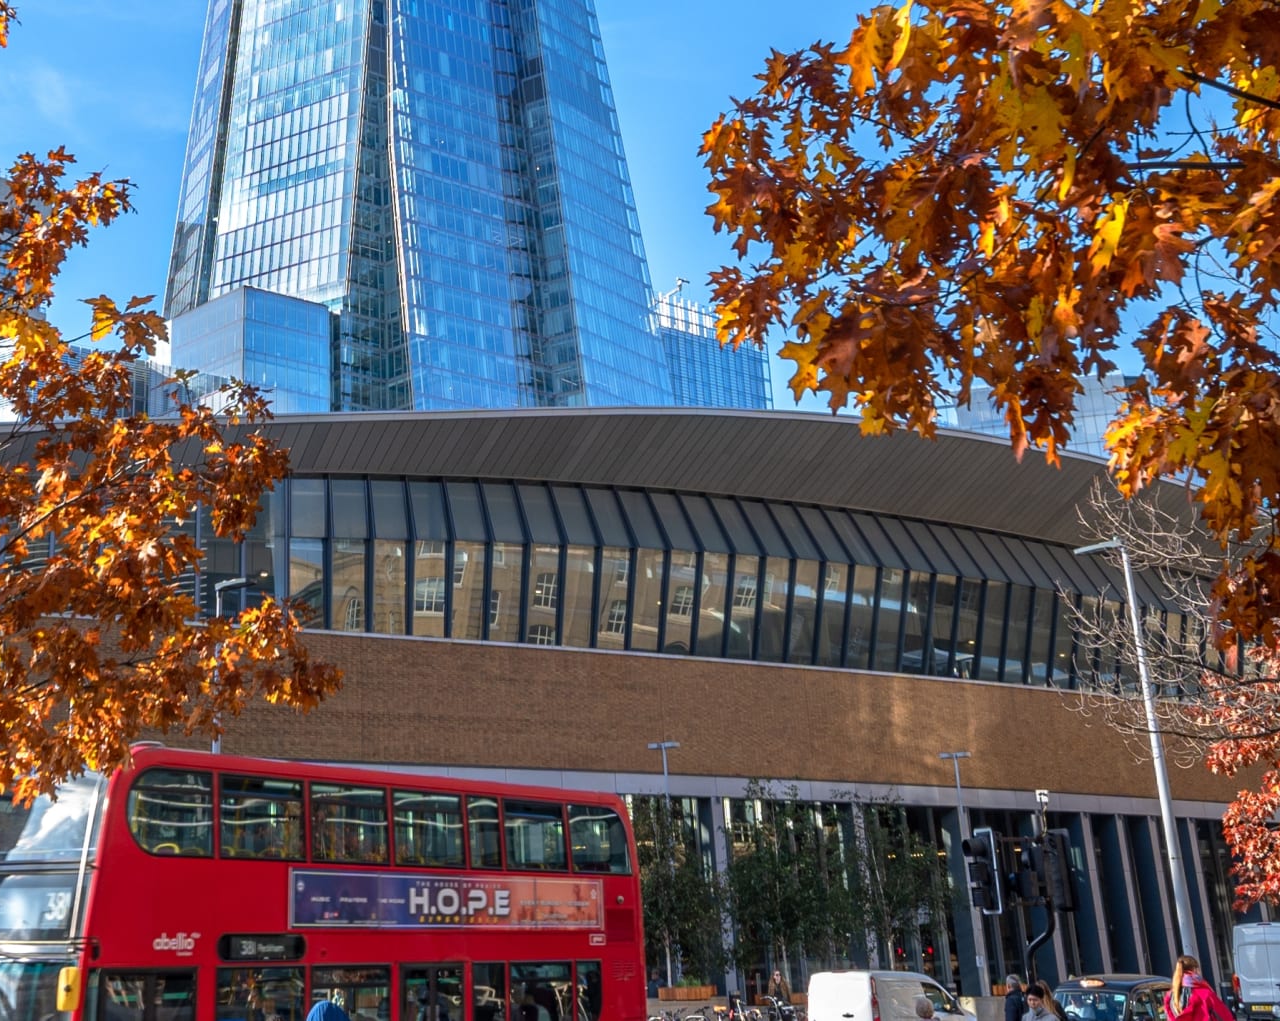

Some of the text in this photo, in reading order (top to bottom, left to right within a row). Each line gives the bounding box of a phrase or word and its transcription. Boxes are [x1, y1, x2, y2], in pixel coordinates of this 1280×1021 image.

[44, 892, 72, 920] 381
[409, 887, 510, 915] H.O.P.E
[153, 932, 195, 950] abellio
